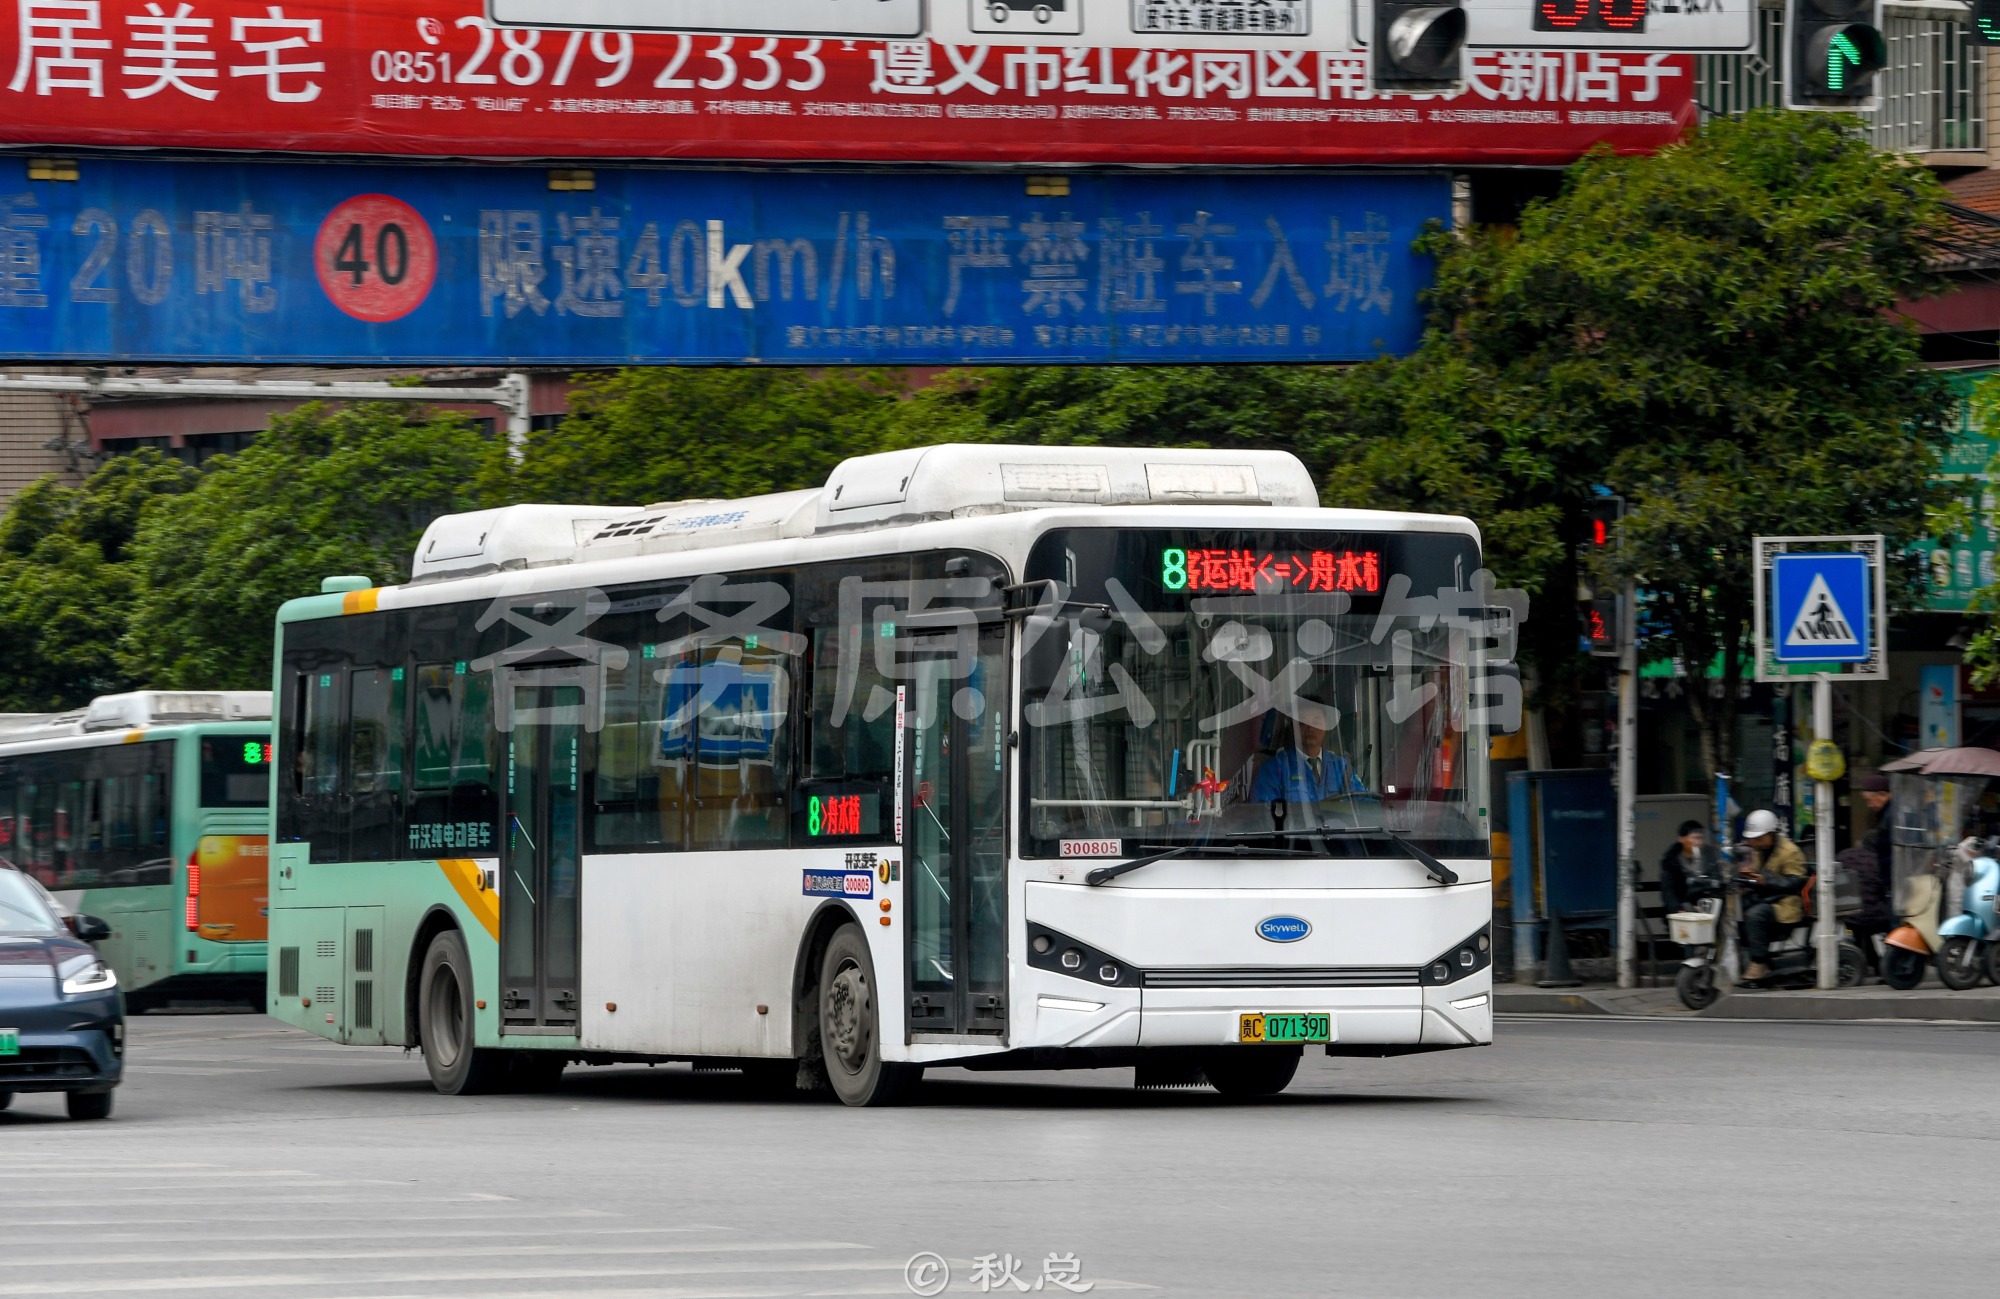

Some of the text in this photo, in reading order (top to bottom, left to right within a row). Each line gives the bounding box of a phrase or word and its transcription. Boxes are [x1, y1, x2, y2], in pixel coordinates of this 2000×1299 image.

[8, 0, 326, 103] 居美宅
[370, 16, 827, 91] 0851 2879 2333
[334, 222, 410, 286] 40
[942, 210, 1392, 318] 严禁脏车入城
[1163, 549, 1187, 589] 8
[243, 742, 262, 764] 8
[408, 821, 491, 850] 开沃纯电动客车
[809, 796, 821, 836] 8
[1063, 842, 1118, 855] 300805
[845, 877, 870, 892] 300805
[1263, 923, 1306, 933] Skywell
